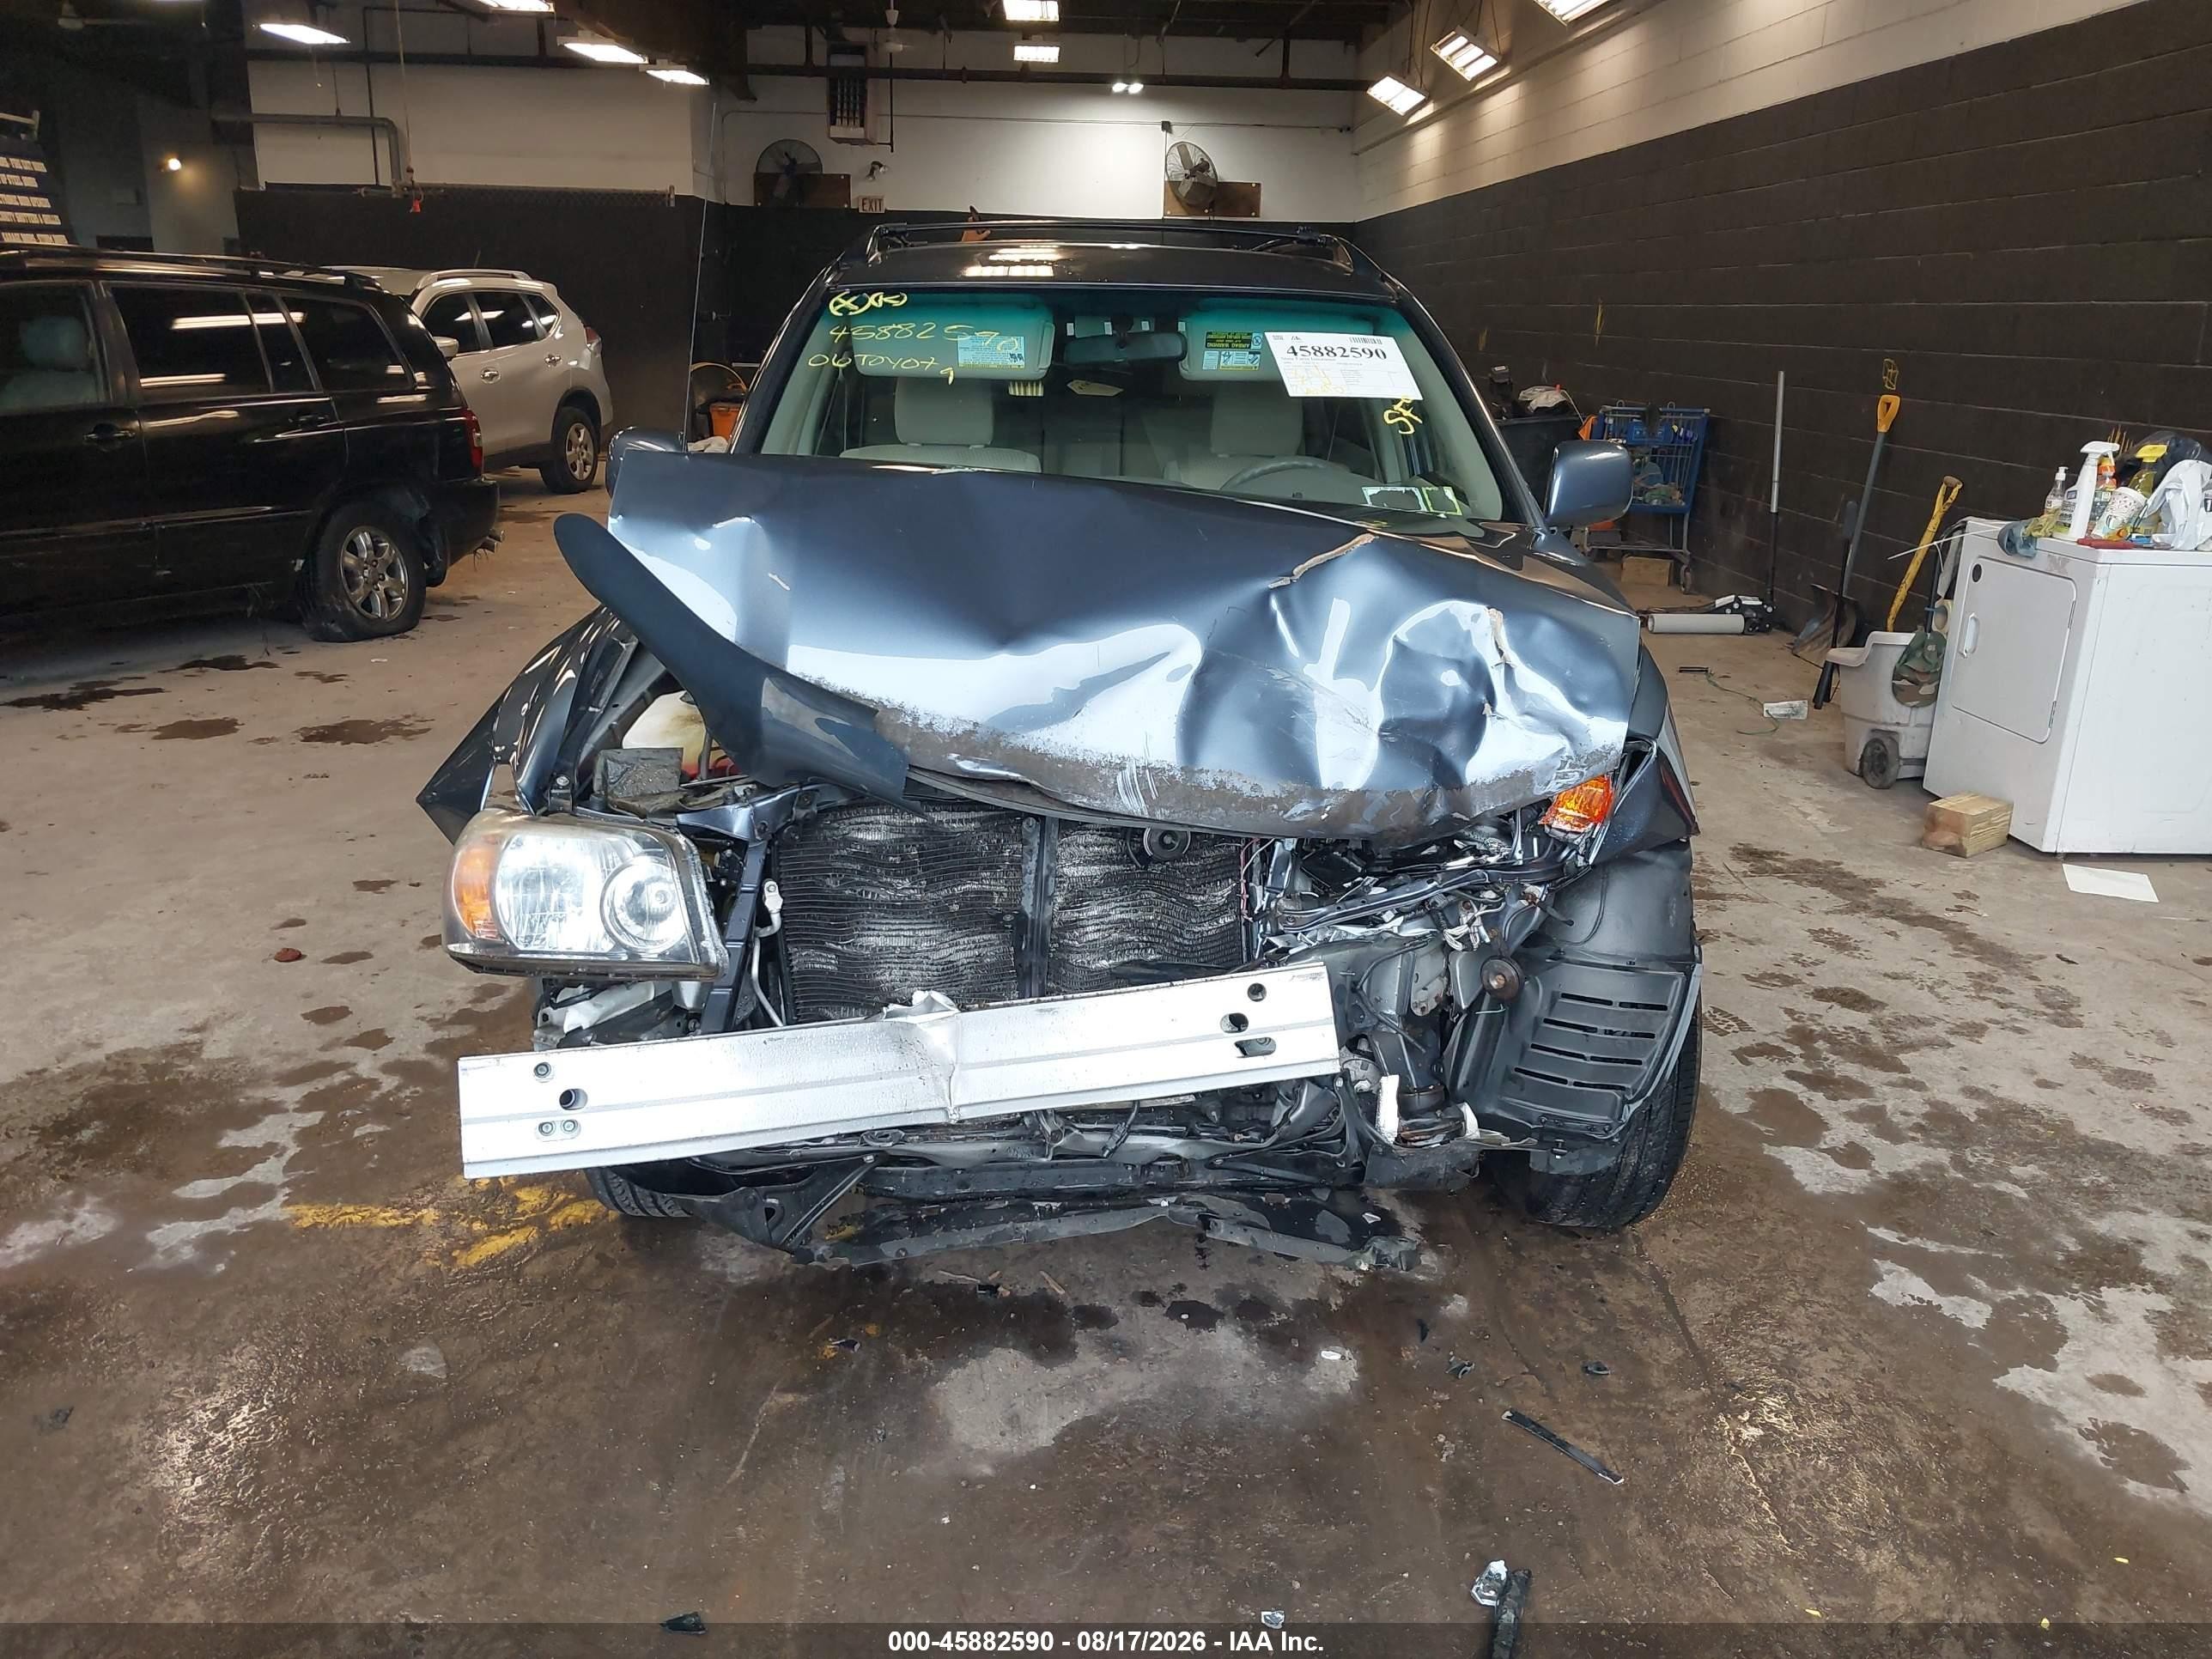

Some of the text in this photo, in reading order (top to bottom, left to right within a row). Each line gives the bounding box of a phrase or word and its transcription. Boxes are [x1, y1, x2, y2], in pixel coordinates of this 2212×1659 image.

[861, 198, 884, 212] EXIT
[1286, 345, 1388, 360] 45882590
[808, 353, 853, 368] 06
